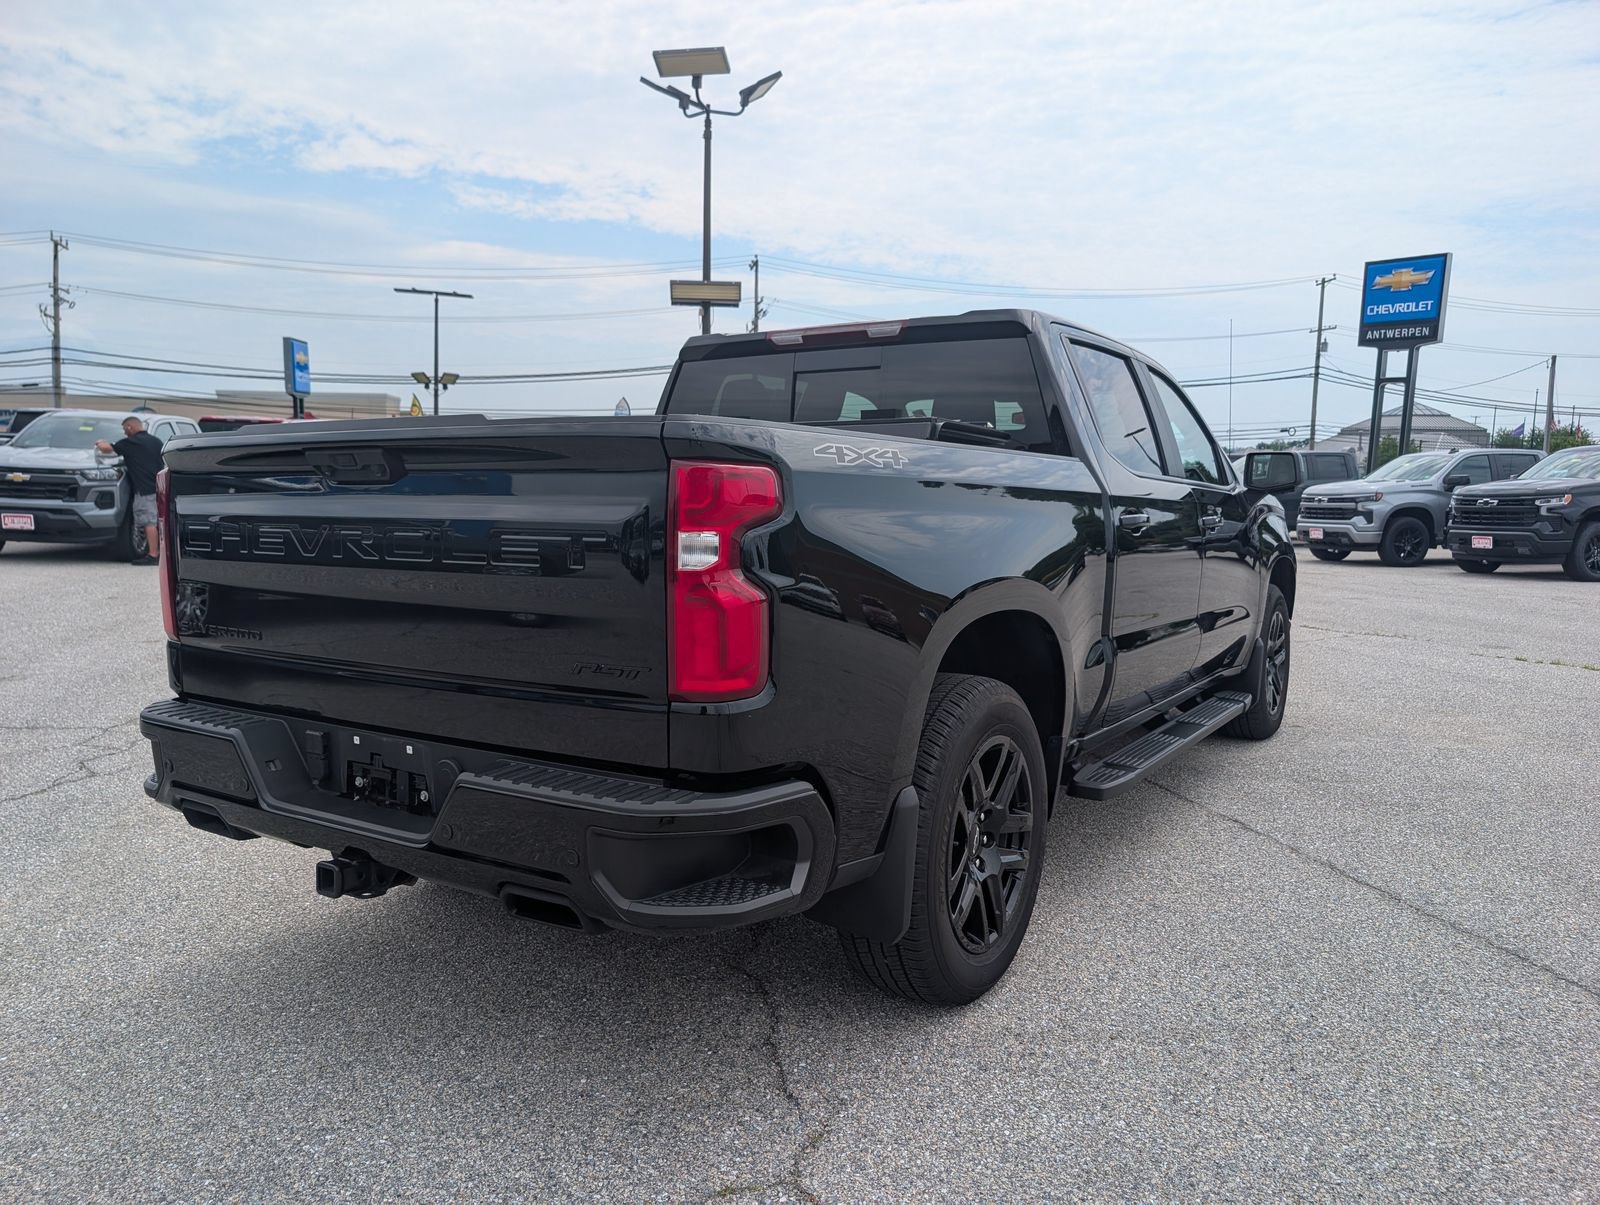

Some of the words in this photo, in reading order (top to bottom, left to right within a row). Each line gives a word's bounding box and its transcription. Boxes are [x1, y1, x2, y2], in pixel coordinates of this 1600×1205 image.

[1367, 300, 1434, 316] CHEVROLET
[1366, 327, 1430, 340] ANTWERPEN
[183, 520, 608, 570] CHEVROLET
